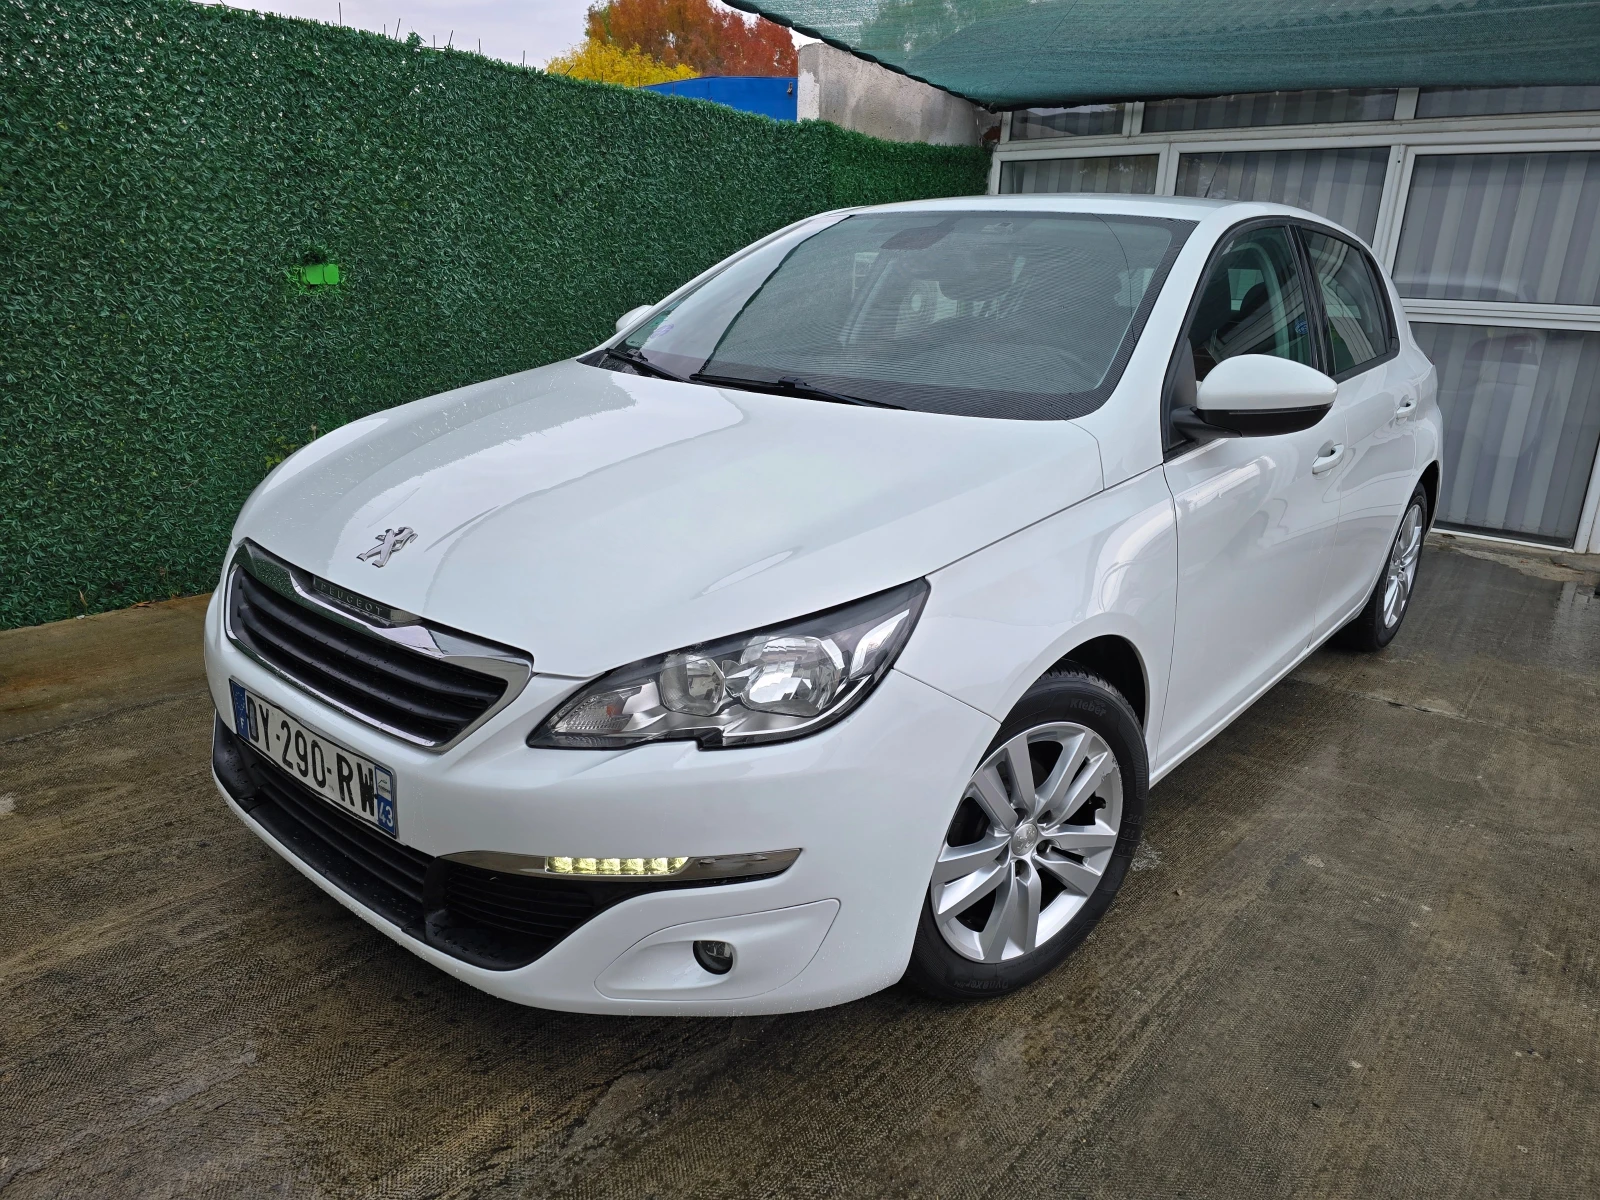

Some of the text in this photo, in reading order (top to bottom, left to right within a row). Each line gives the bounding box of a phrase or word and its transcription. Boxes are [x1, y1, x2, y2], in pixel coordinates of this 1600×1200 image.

[320, 583, 383, 616] PEUGEOT
[1070, 698, 1107, 717] Kleber
[240, 717, 245, 729] F
[246, 693, 375, 817] DY-290-RW
[379, 801, 394, 827] 43
